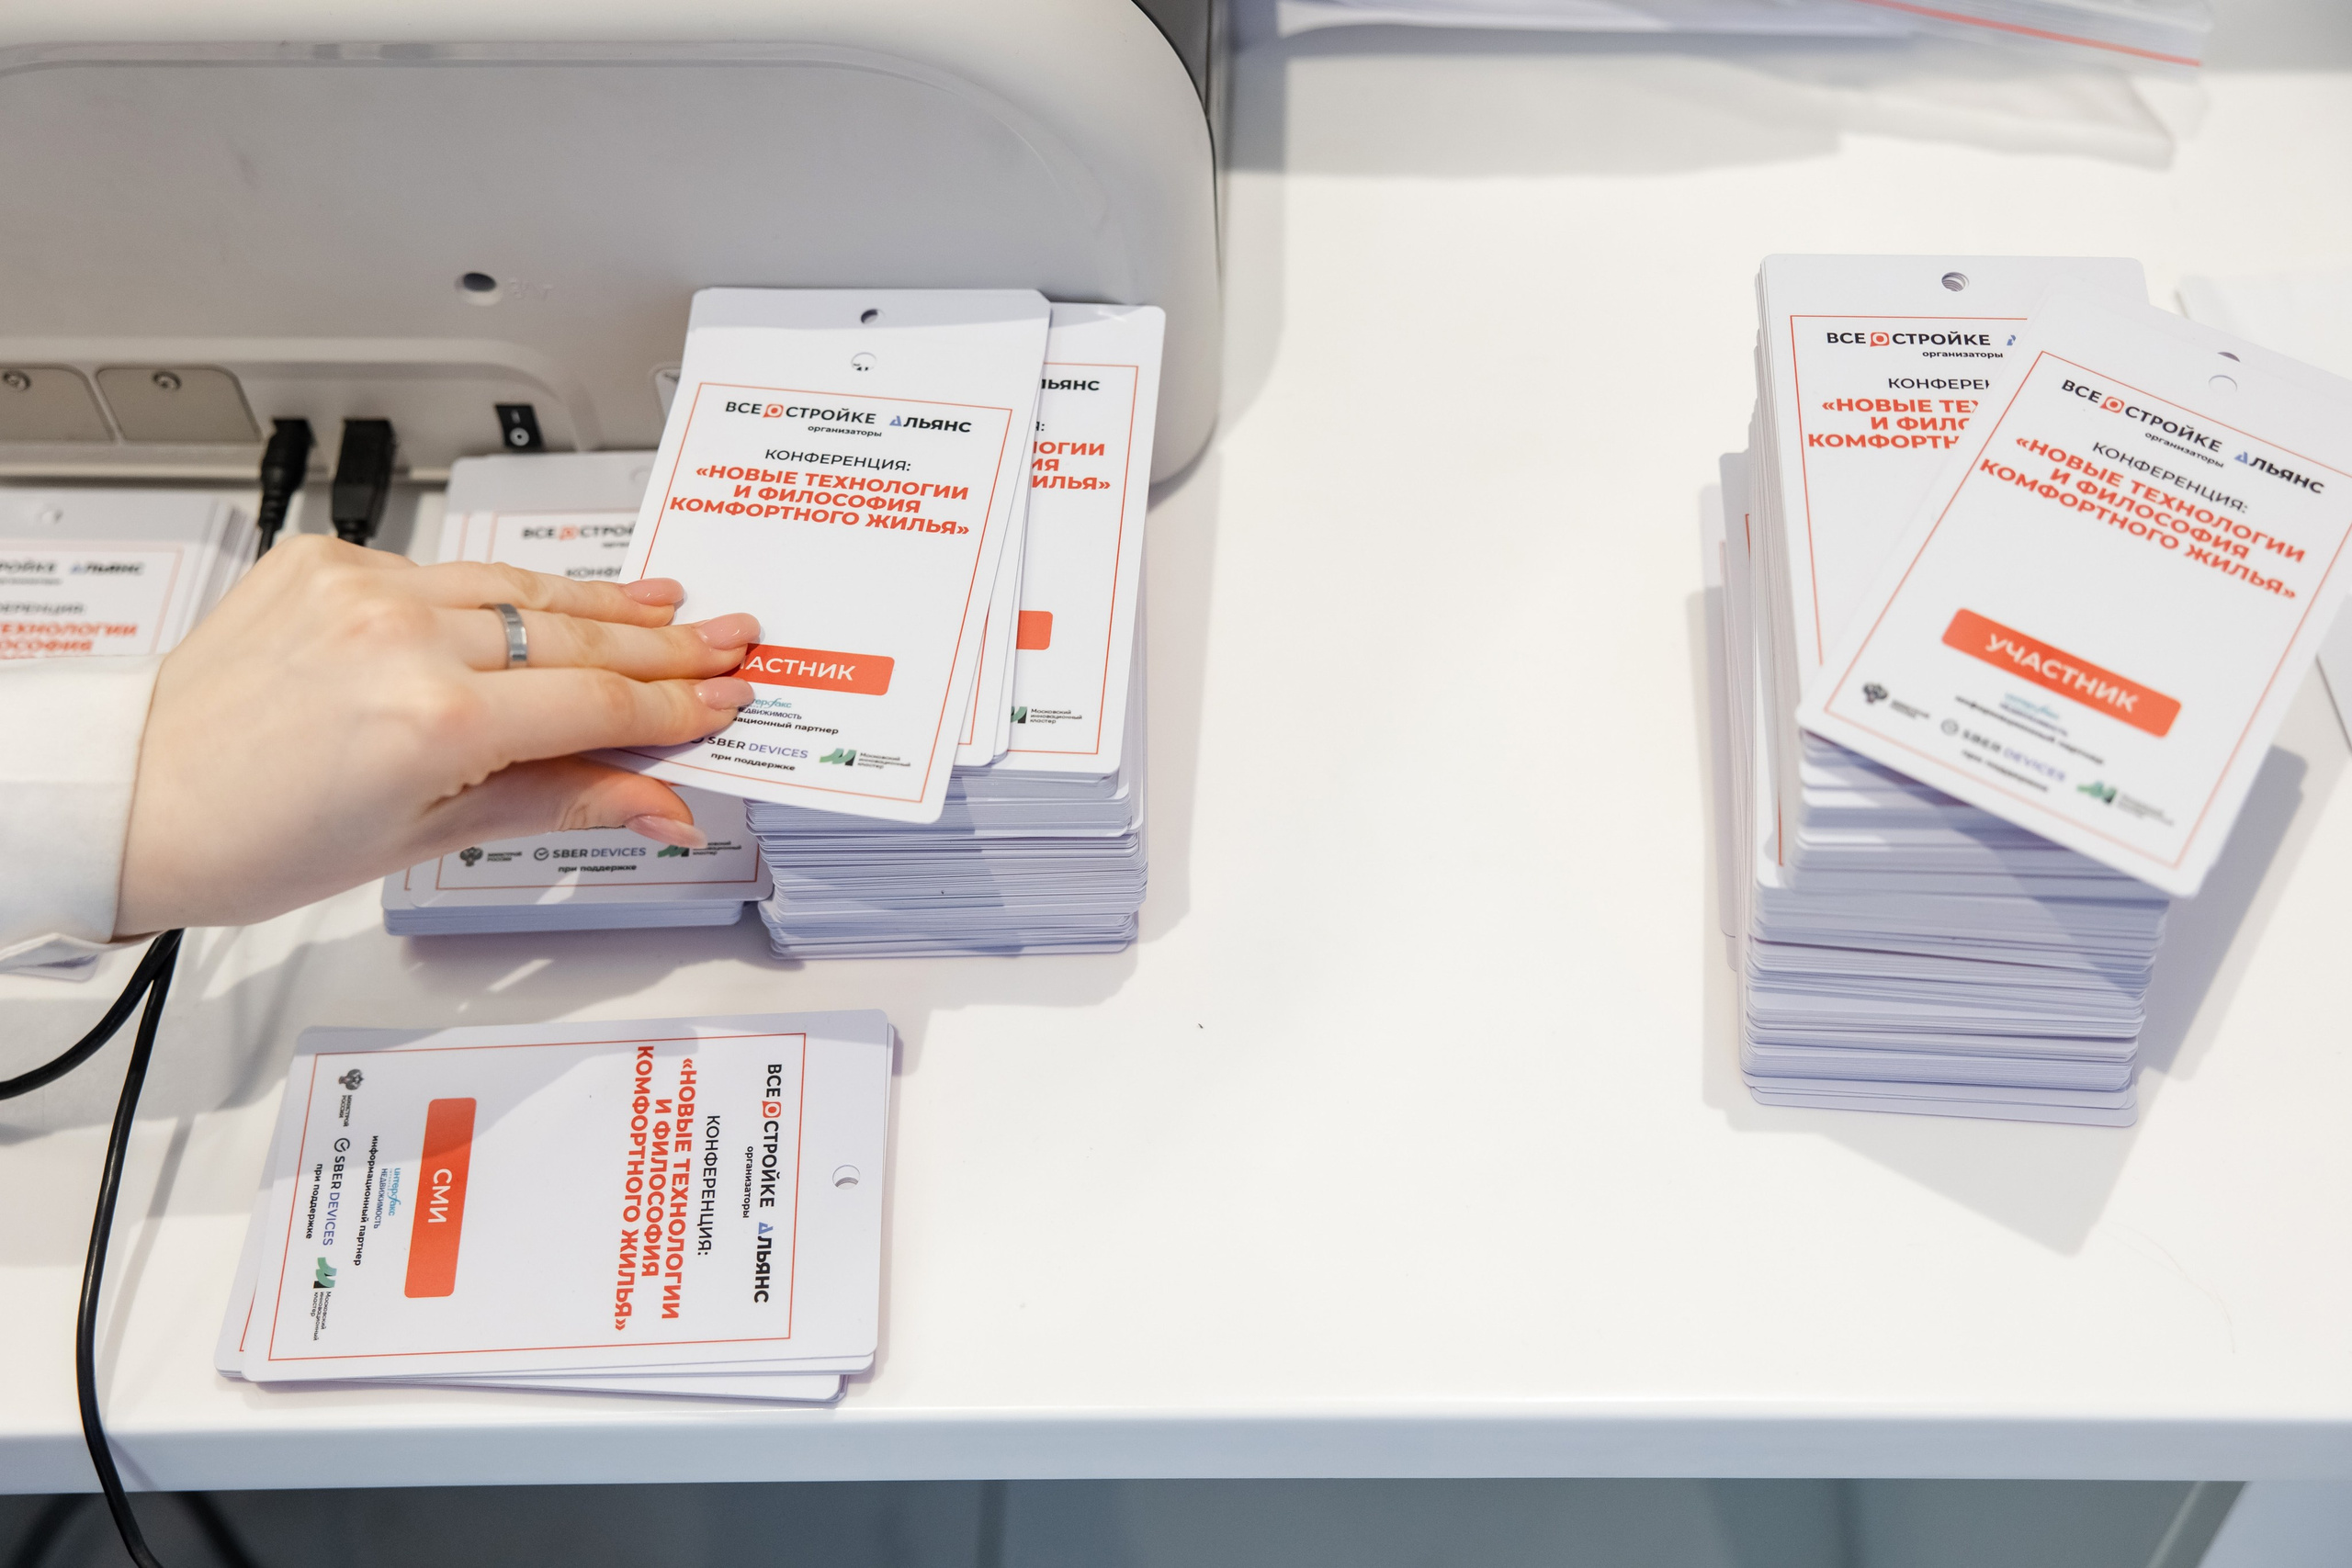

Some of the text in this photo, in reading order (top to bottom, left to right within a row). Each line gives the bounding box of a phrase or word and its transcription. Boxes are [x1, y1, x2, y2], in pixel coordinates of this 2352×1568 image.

[1888, 378, 1989, 389] КОНФЕРЕ
[1822, 398, 1932, 412] «НОВЫЕ
[1871, 417, 1888, 430] И
[808, 425, 882, 437] организаторы
[1808, 434, 1960, 449] КОМФОРТН
[2144, 432, 2224, 468] организаторы
[765, 449, 910, 471] КОНФЕРЕНЦИЯ:
[2092, 442, 2248, 513] КОНФЕРЕНЦИЯ:
[695, 465, 968, 500] «НОВЫЕ ТЕХНОЛОГИИ
[733, 484, 921, 513] И ФИЛОСОФИЯ
[1032, 475, 1111, 490] ИЛЬЯ»
[2016, 436, 2306, 562] «НОВЫЕ ТЕХНОЛОГИИ
[670, 497, 969, 535] КОМФОРТНОГО ЖИЛЬЯ»
[1980, 459, 2296, 599] КОМФОРТНОГО ЖИЛЬЯ»
[2050, 468, 2249, 559] И ФИЛОСОФИЯ
[740, 656, 855, 681] АСТНИК
[1985, 634, 2139, 713] УЧАСТНИК
[733, 716, 839, 735] ационный партнер
[707, 736, 808, 759] SBER DEVICES
[711, 751, 796, 772] при поддержке
[553, 847, 647, 858] SBER DEVICES
[322, 1156, 345, 1246] SBER DEVICES
[354, 1136, 379, 1266] информационный партнер
[374, 1168, 388, 1229] НЕДВИЖИМОСТЬ
[428, 1168, 452, 1223] СМИ
[615, 1046, 653, 1330] КОМФОРТНОГО ЖИЛЬЯ»
[641, 1099, 672, 1277] И ФИЛОСОФИЯ
[662, 1058, 696, 1319] «НОВЫЕ ТЕХНОЛОГИИ
[697, 1115, 720, 1256] КОНФЕРЕНЦИЯ:
[742, 1146, 754, 1218] организаторы
[306, 1164, 323, 1239] при поддержке
[313, 1292, 324, 1340] инновационный
[321, 1292, 331, 1329] Московский
